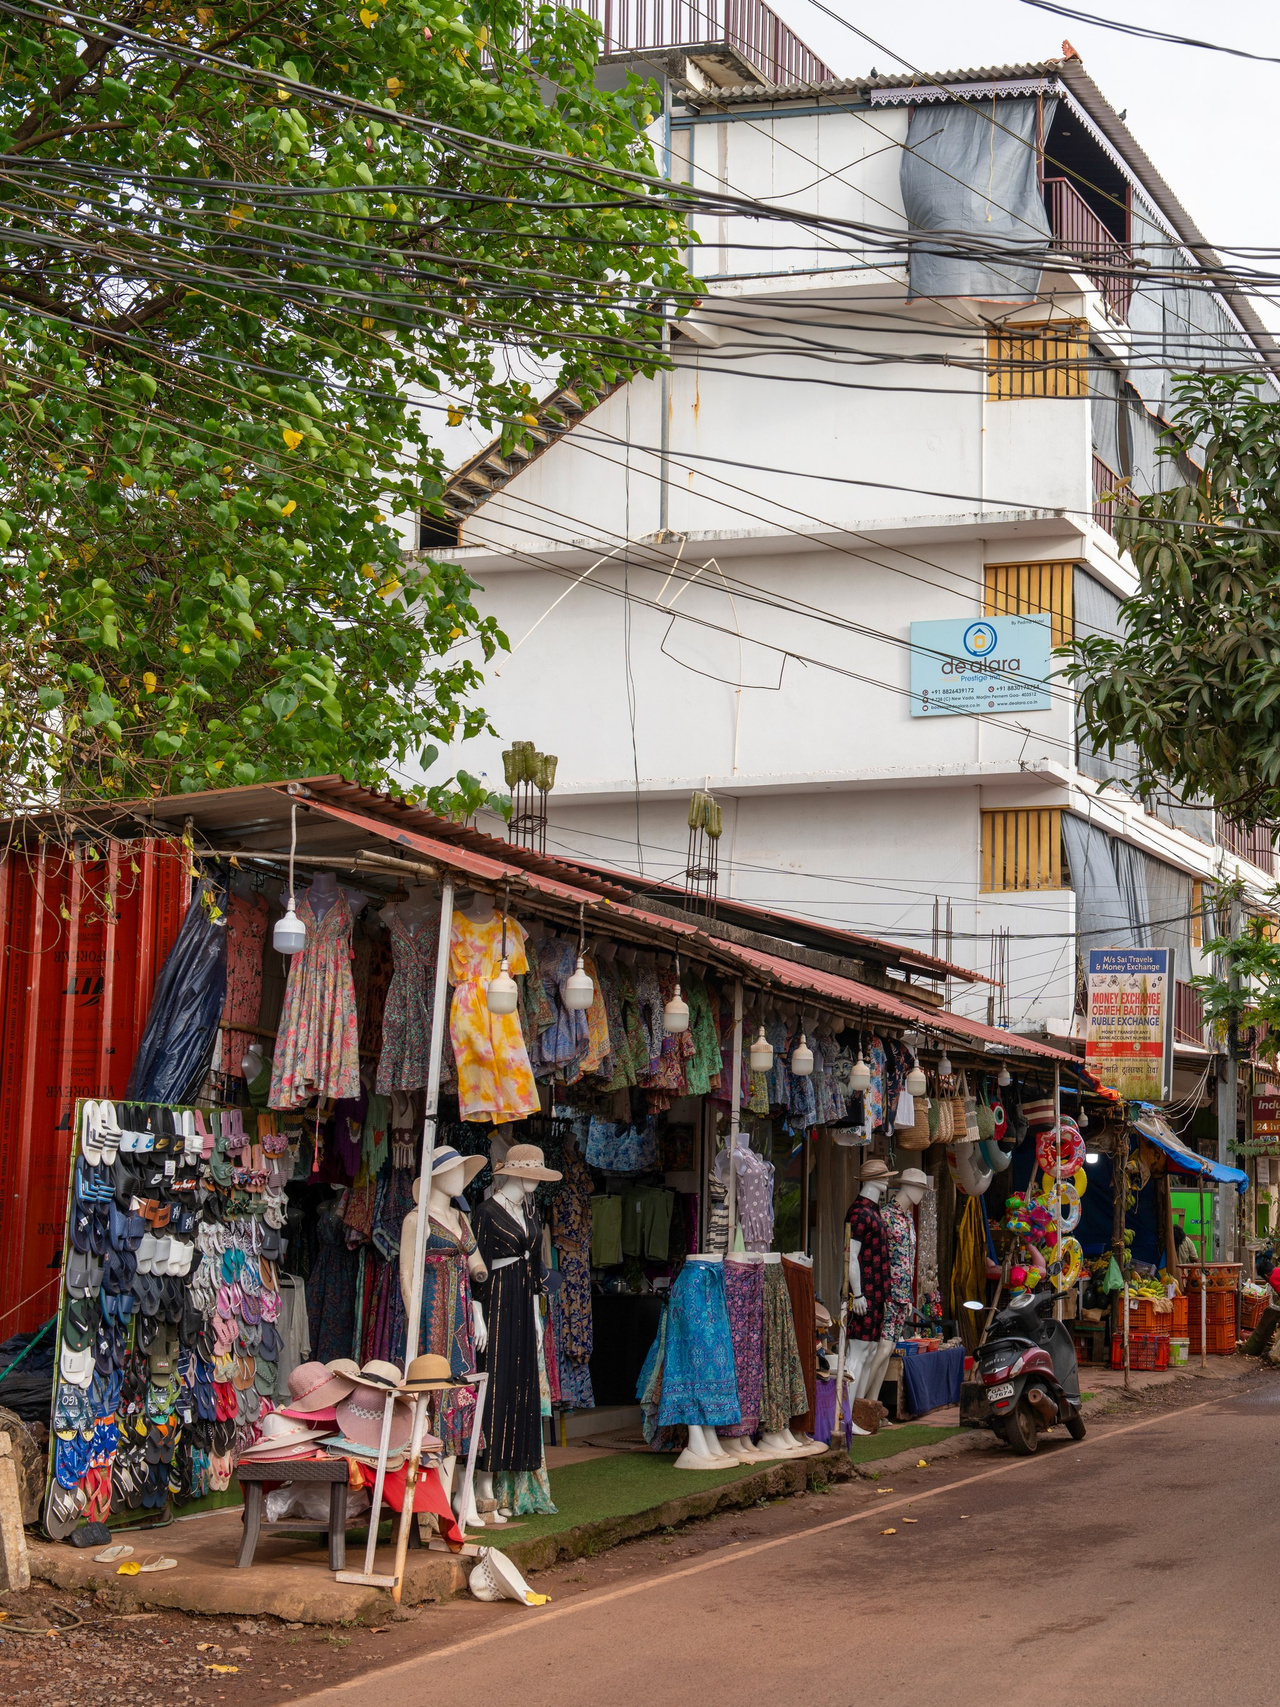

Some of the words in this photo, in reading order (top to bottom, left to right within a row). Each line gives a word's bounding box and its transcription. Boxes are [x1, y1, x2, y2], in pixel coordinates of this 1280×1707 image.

[942, 658, 966, 674] de
[970, 657, 1020, 673] alara
[1102, 964, 1126, 972] Money
[1127, 964, 1160, 972] Exchange
[1092, 992, 1118, 1004] MONEY
[1120, 992, 1161, 1004] EXCHANGE
[1092, 1006, 1120, 1016] ОБМЕН
[1124, 1006, 1160, 1016] ВАЛЮТЫ
[1092, 1017, 1115, 1026] RUBLE
[1118, 1017, 1160, 1026] EXCHANGE
[1256, 1122, 1268, 1130] 24
